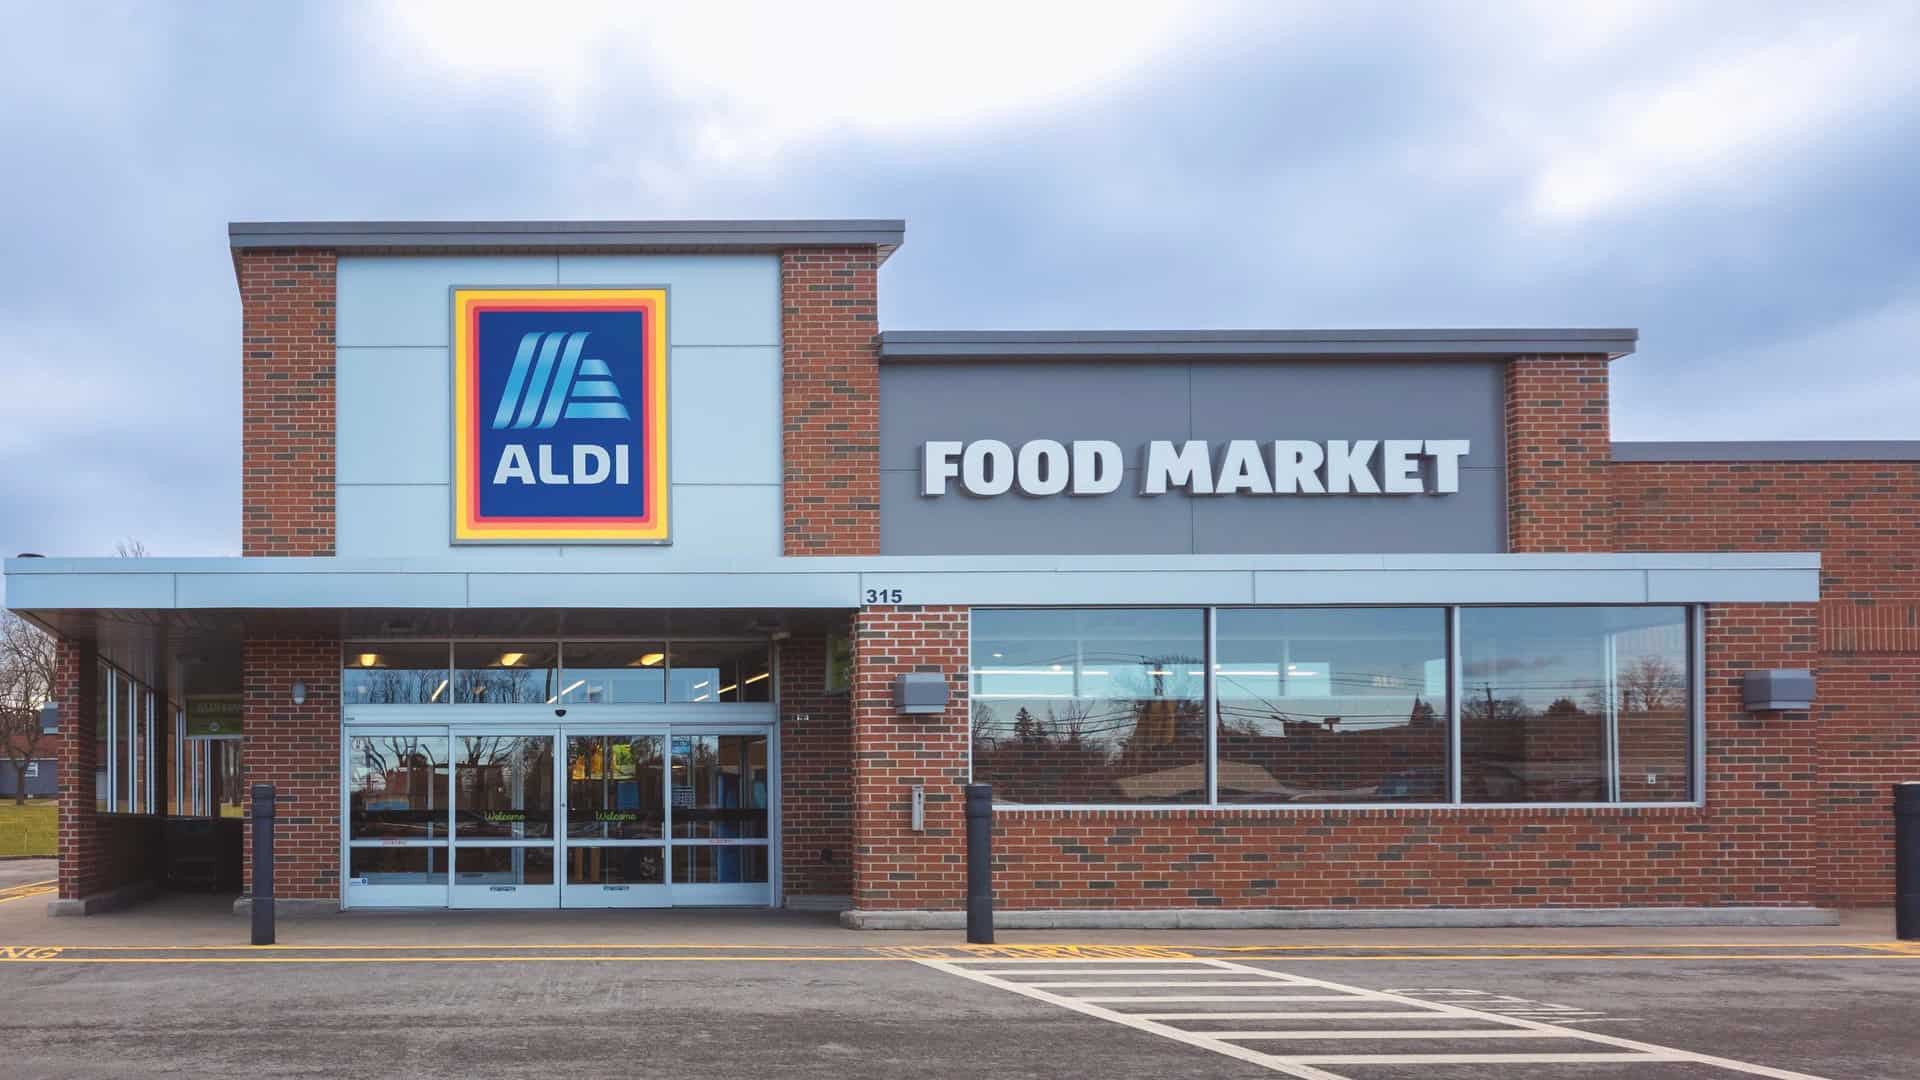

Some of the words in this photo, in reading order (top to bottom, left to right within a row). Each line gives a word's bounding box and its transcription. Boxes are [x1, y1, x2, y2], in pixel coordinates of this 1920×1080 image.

[493, 444, 629, 485] ALDI
[921, 439, 1124, 496] FOOD
[1140, 439, 1471, 495] MARKET
[866, 589, 903, 604] 315
[484, 809, 526, 822] Welcome
[595, 809, 637, 822] Welcome
